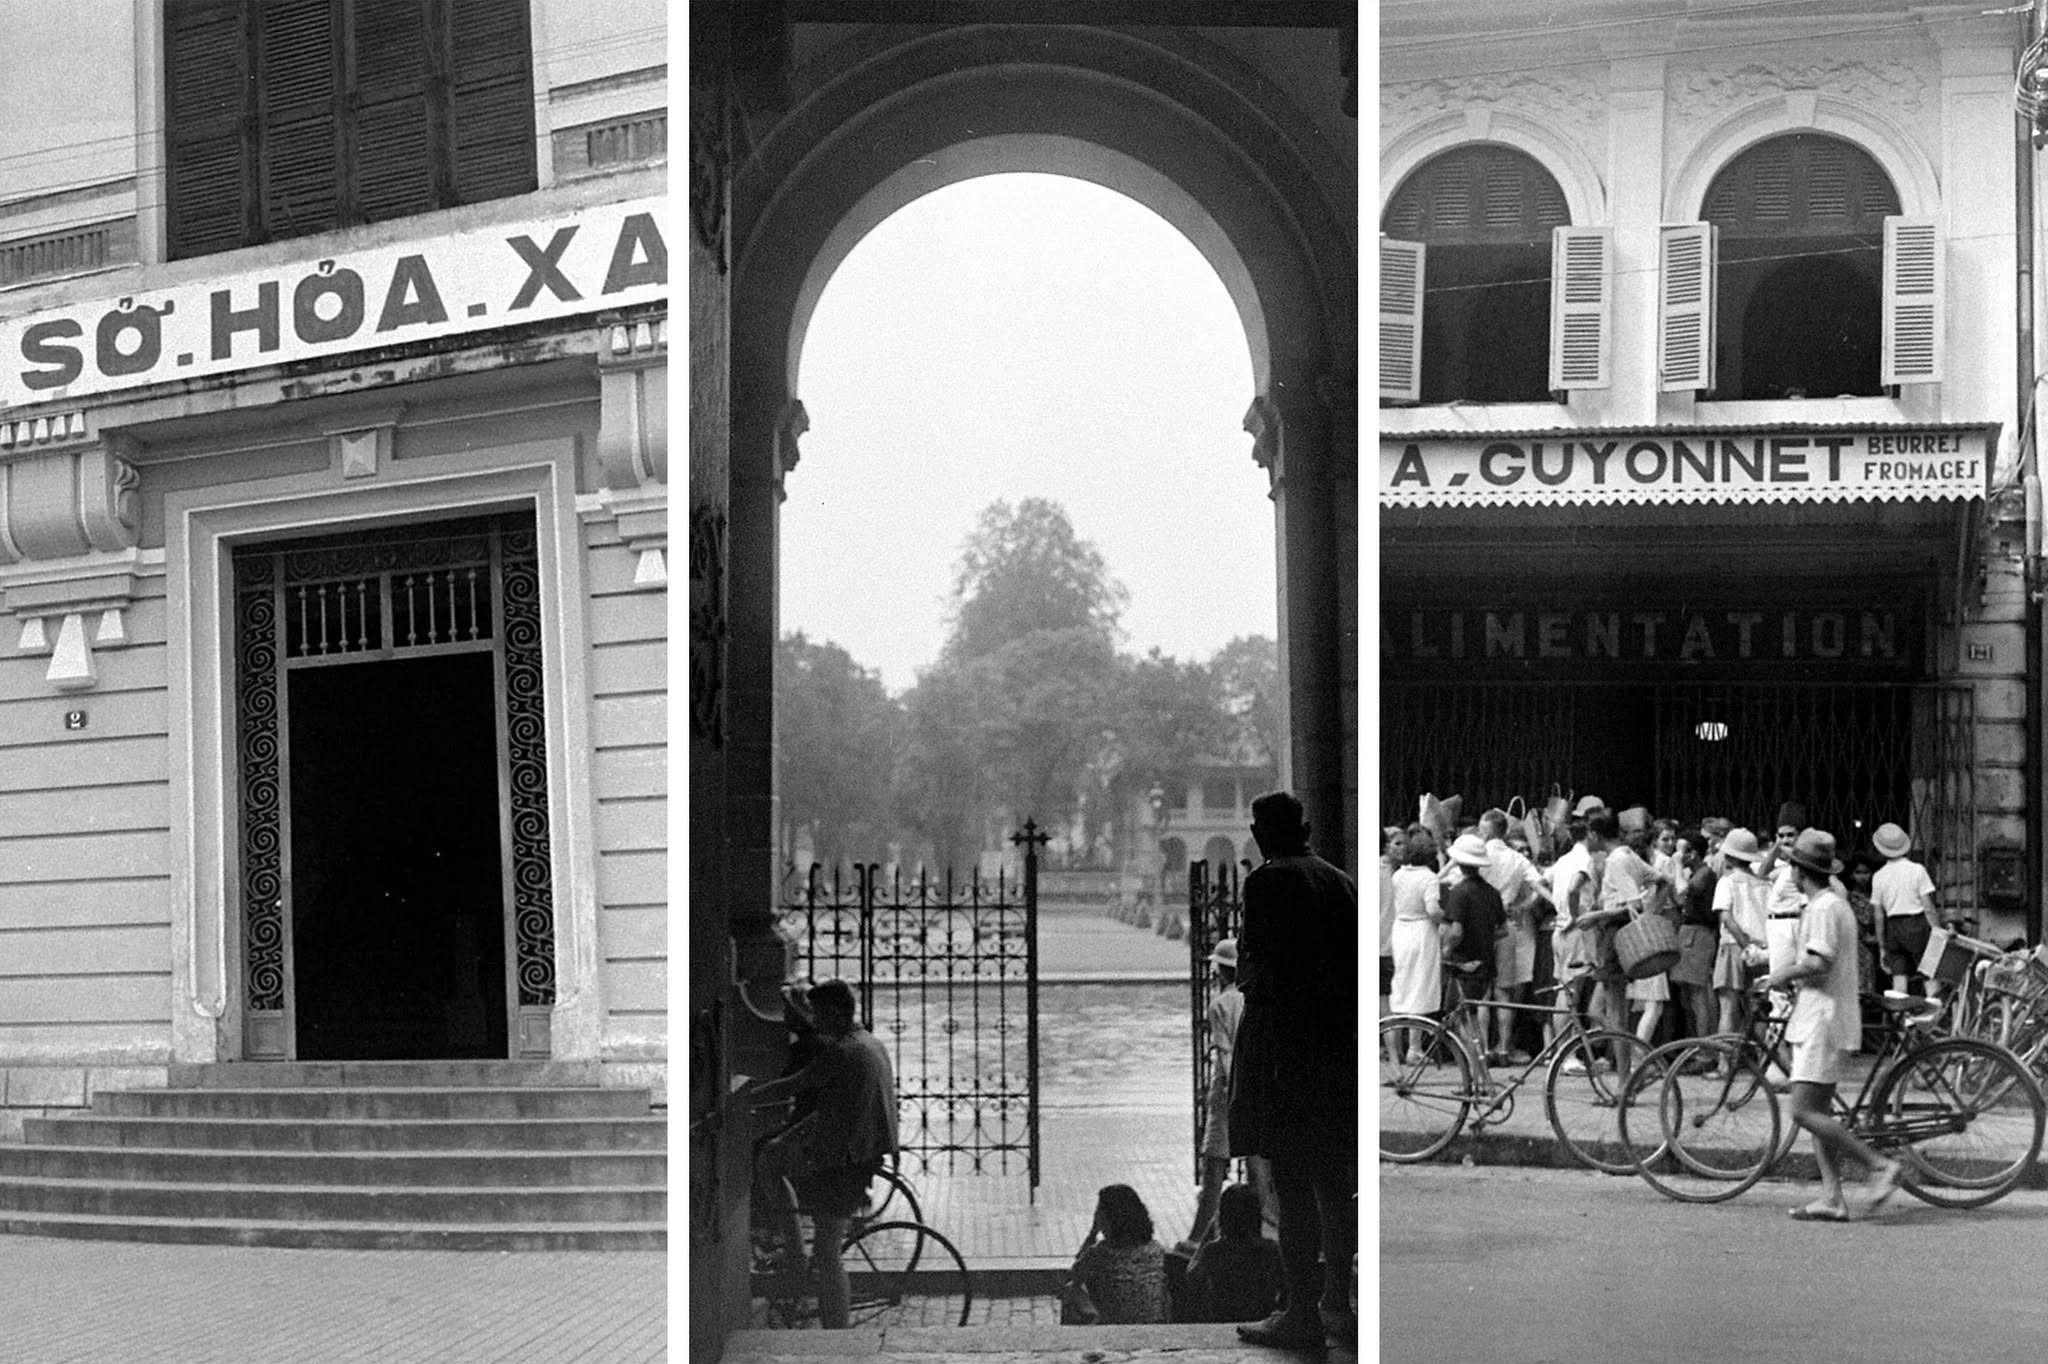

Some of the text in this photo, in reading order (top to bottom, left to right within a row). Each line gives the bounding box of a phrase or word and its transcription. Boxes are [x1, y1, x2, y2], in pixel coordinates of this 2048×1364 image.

[1868, 434, 1963, 455] BEURRES
[1480, 437, 1854, 486] GUYONNET
[1864, 461, 1979, 480] FROMAGES
[70, 711, 81, 728] 2
